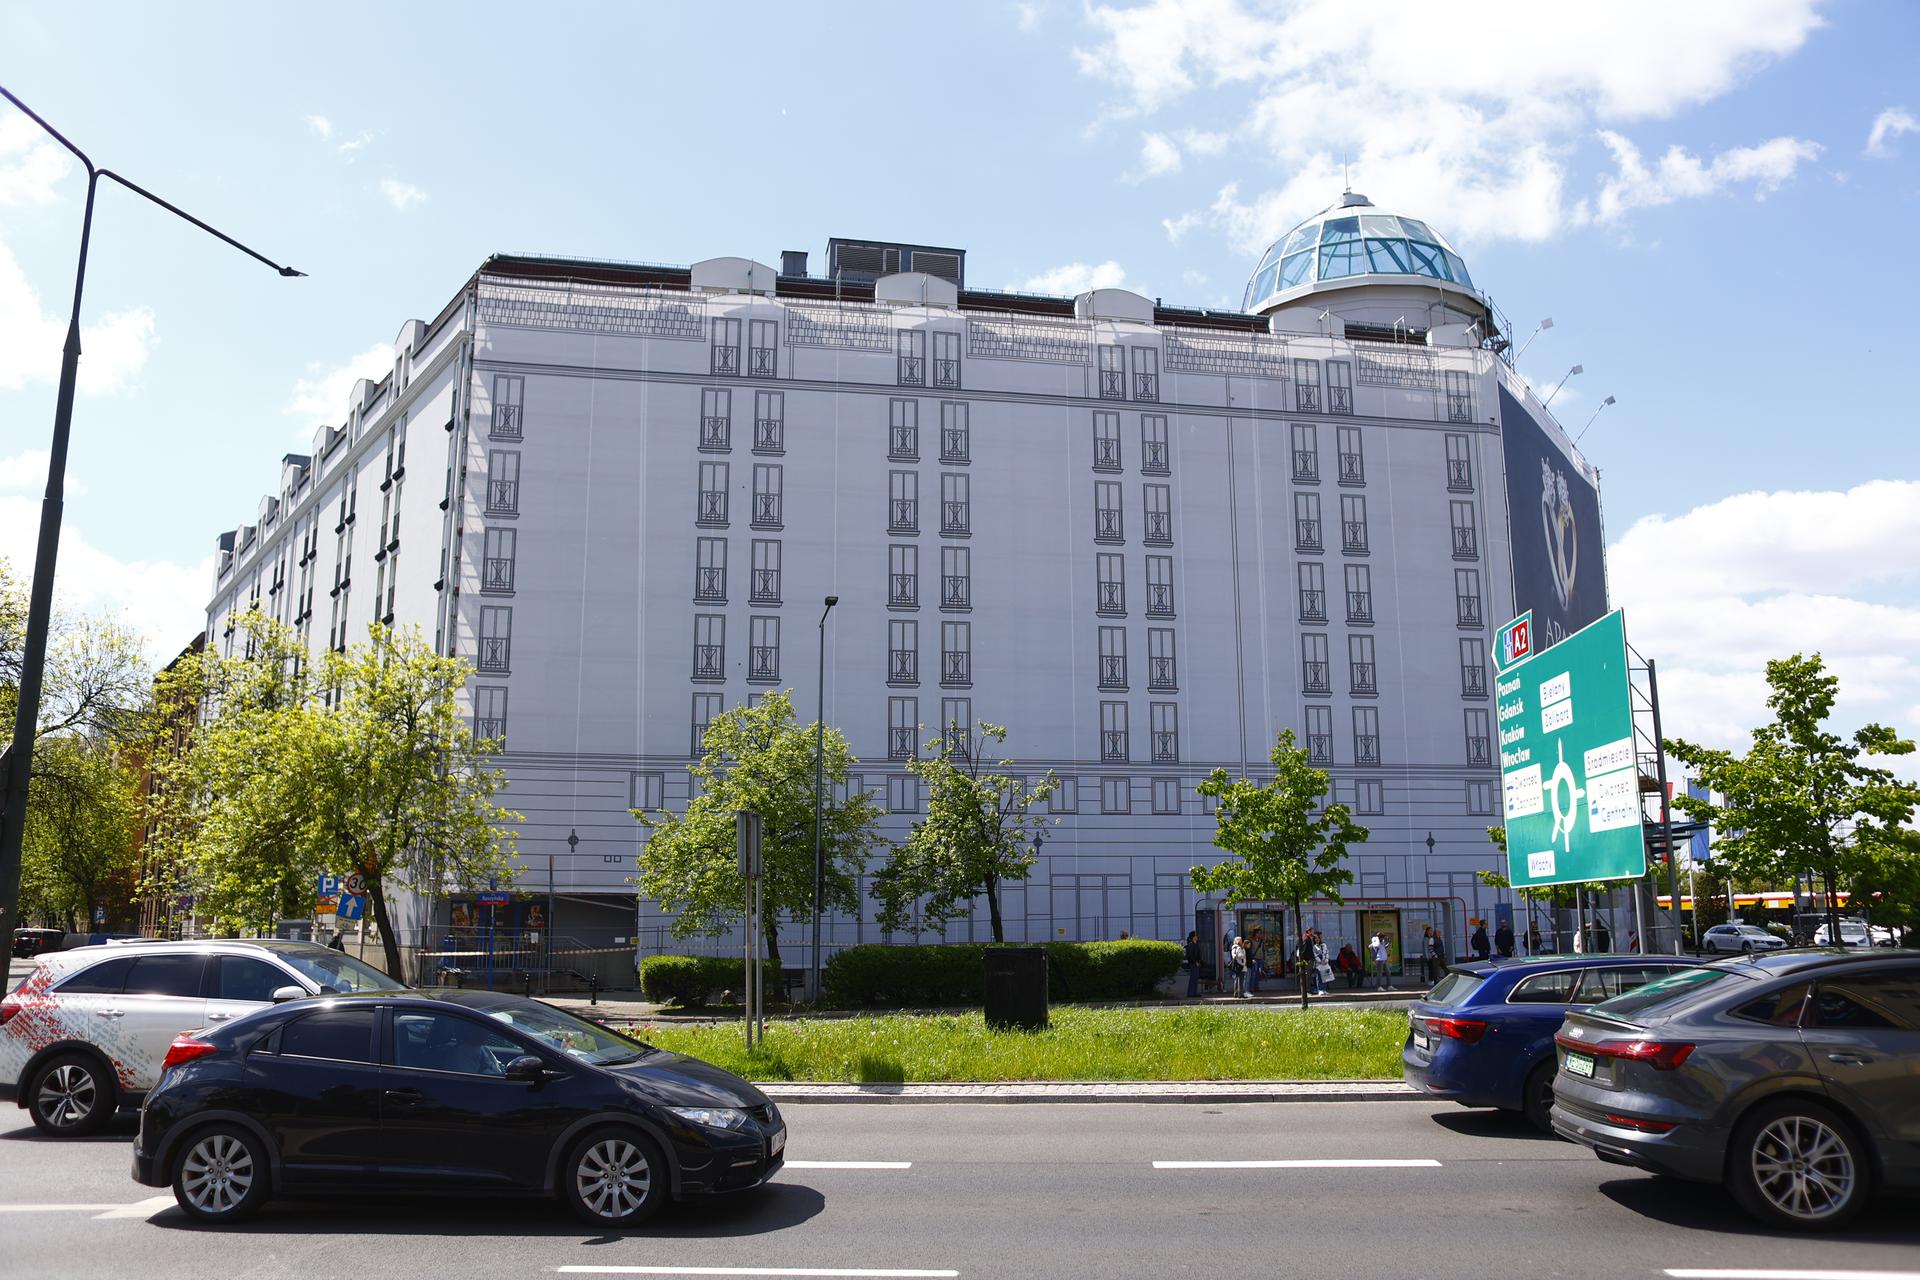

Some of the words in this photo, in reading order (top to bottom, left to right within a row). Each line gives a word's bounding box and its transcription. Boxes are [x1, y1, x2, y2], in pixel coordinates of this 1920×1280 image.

[1514, 627, 1527, 653] A2
[1498, 673, 1521, 698] Poznań
[1499, 698, 1524, 721] Gdańsk
[1501, 724, 1525, 746] Kraków
[1502, 747, 1530, 769] Wrocław
